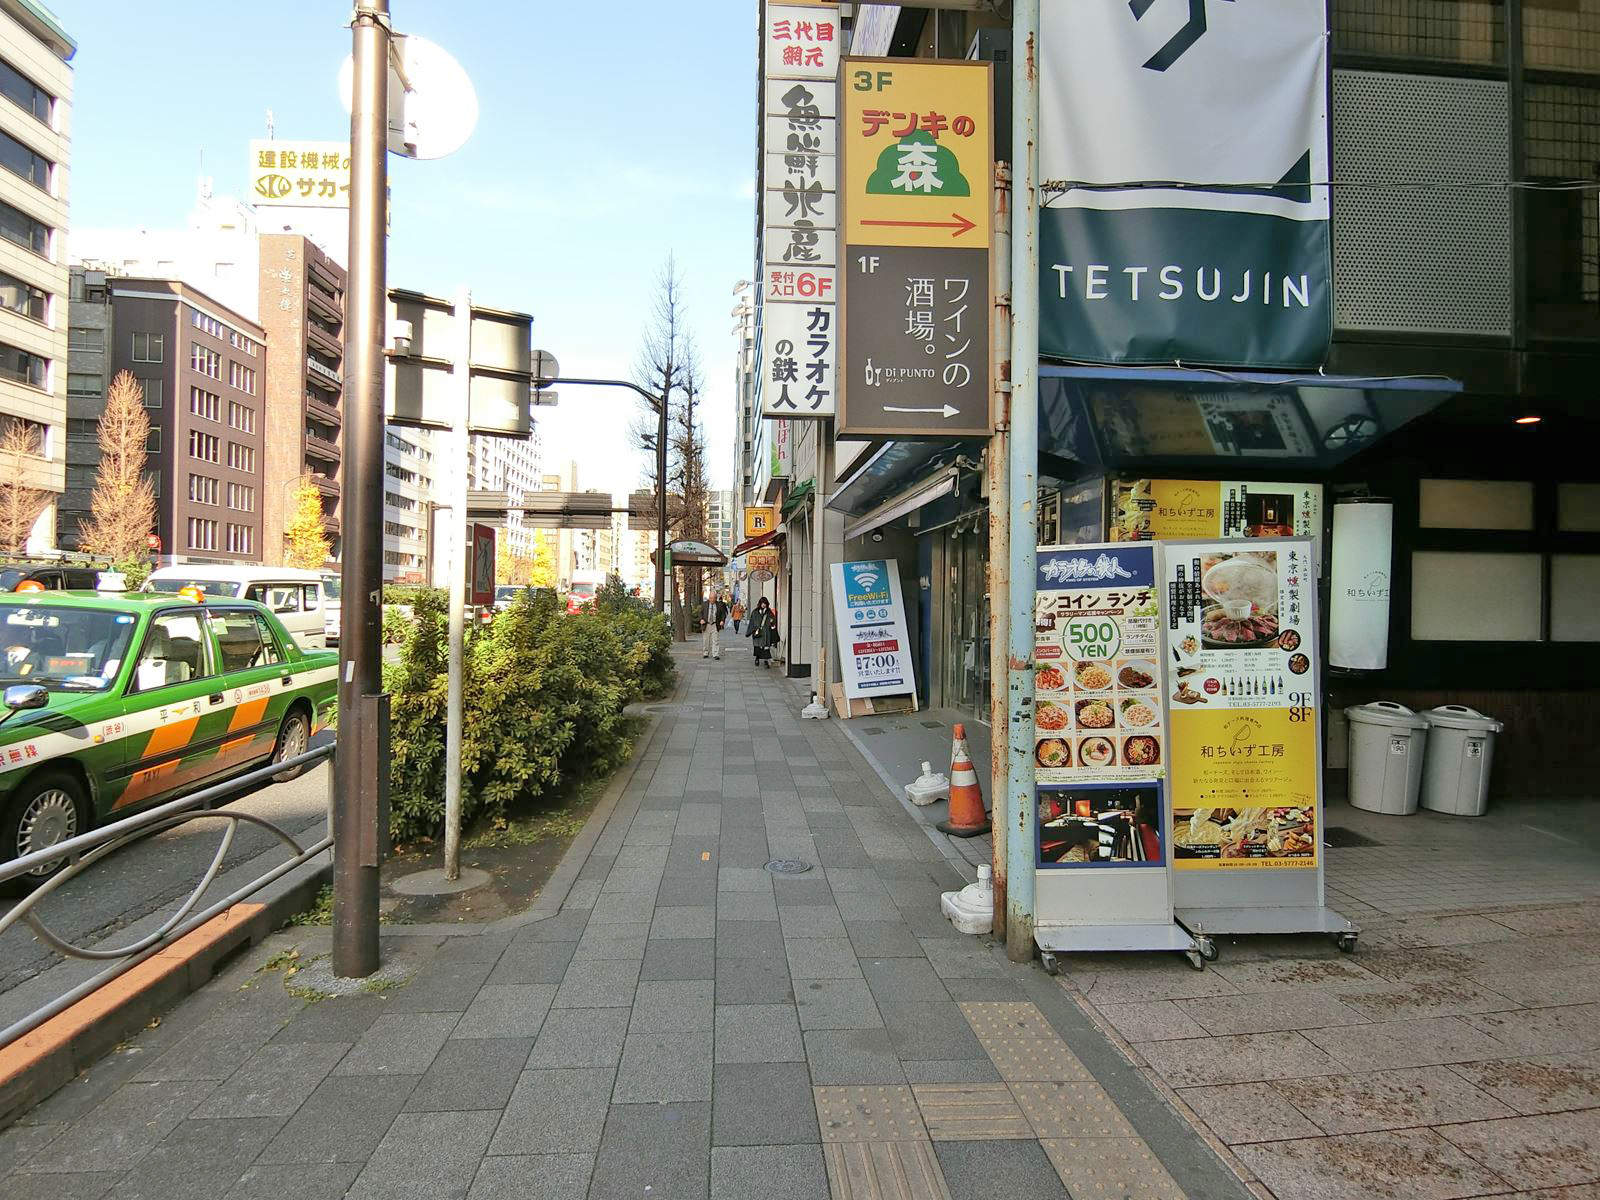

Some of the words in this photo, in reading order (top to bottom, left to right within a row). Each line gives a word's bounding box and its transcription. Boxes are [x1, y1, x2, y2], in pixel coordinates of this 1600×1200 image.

[772, 20, 834, 41] 三代目
[783, 45, 824, 67] 網元
[854, 70, 893, 92] 3F
[862, 109, 976, 139] デンキの
[890, 141, 944, 193] 森
[858, 256, 880, 273] 1F
[770, 271, 795, 283] 受付
[797, 272, 832, 297] 6F
[1051, 264, 1309, 307] TETSUJIN
[770, 284, 795, 296] 入口
[905, 277, 936, 355] 酒場。
[943, 279, 971, 388] ワインの
[805, 307, 830, 410] カラオケ
[772, 339, 799, 410] の鉄人
[885, 367, 897, 378] Di
[900, 368, 935, 378] PUNTO
[1158, 507, 1215, 518] 和ちいず工房
[1040, 553, 1131, 583] カラオケの鉄人
[1107, 591, 1151, 608] ランチ
[1070, 623, 1113, 643] 500
[1078, 644, 1107, 657] YEN
[862, 654, 895, 669] 7:00
[1288, 692, 1312, 707] 9F
[1288, 707, 1312, 722] 8F
[1200, 743, 1285, 758] 和ちいず工房
